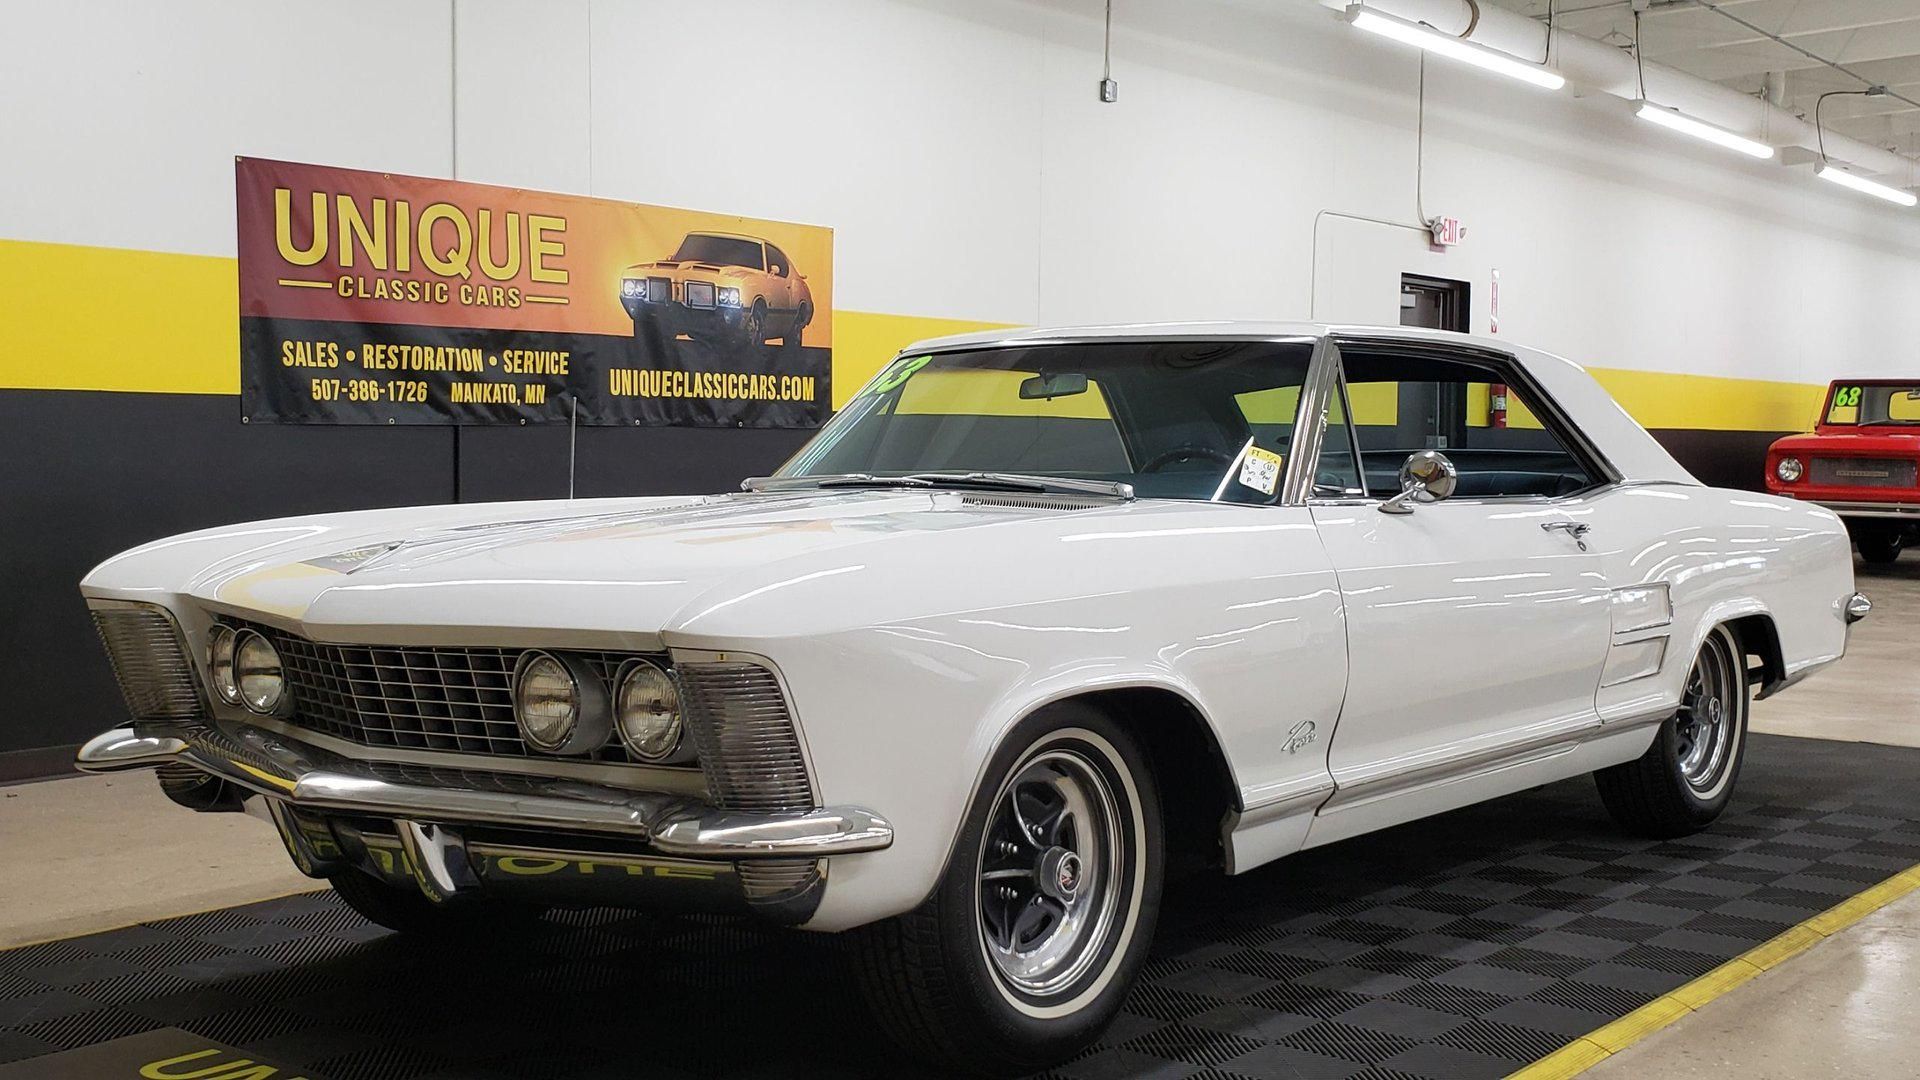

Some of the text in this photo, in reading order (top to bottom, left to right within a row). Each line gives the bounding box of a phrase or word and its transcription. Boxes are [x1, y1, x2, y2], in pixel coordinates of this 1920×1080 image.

[274, 188, 569, 284] UNIQUE
[338, 276, 521, 308] CLASSIC CARS
[282, 340, 570, 375] SALES RESTORATION SERVICE
[311, 378, 546, 407] 507-386-1726 MANKATO, MN
[609, 368, 815, 402] UNIQUECLASSICCARS.COM
[1836, 386, 1862, 407] 68
